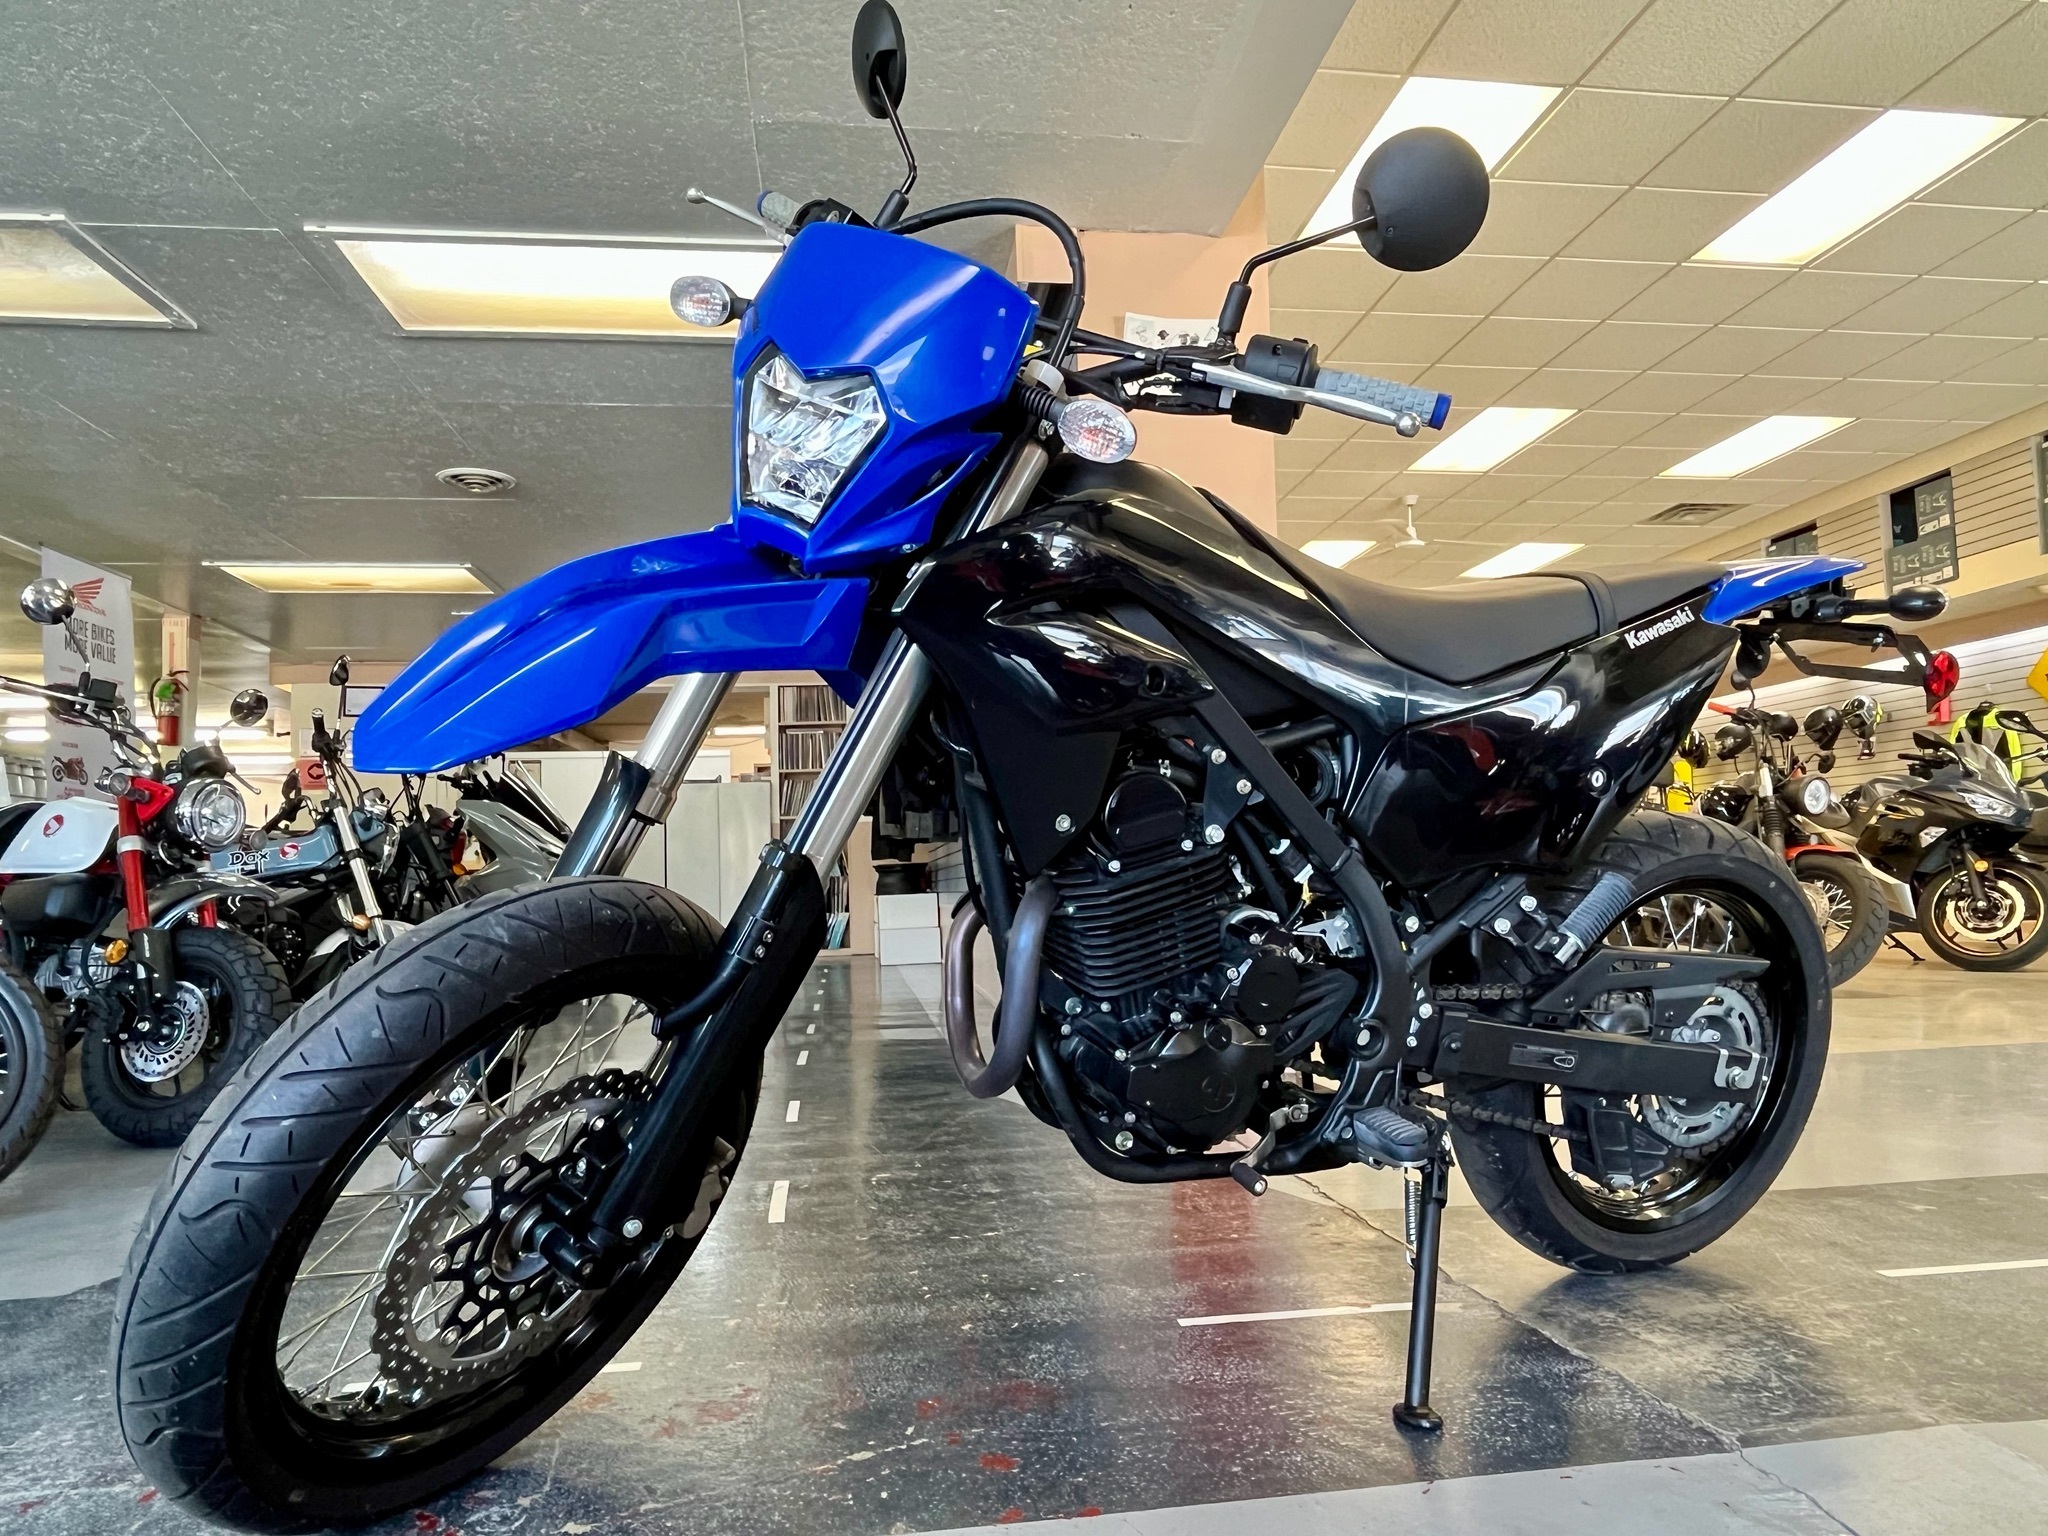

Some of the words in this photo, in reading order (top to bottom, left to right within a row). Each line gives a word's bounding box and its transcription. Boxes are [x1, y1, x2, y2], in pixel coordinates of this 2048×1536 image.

[91, 623, 115, 646] BIKES
[1624, 606, 1695, 649] Kawasaki
[90, 642, 116, 664] VALUE
[228, 851, 270, 866] Dax
